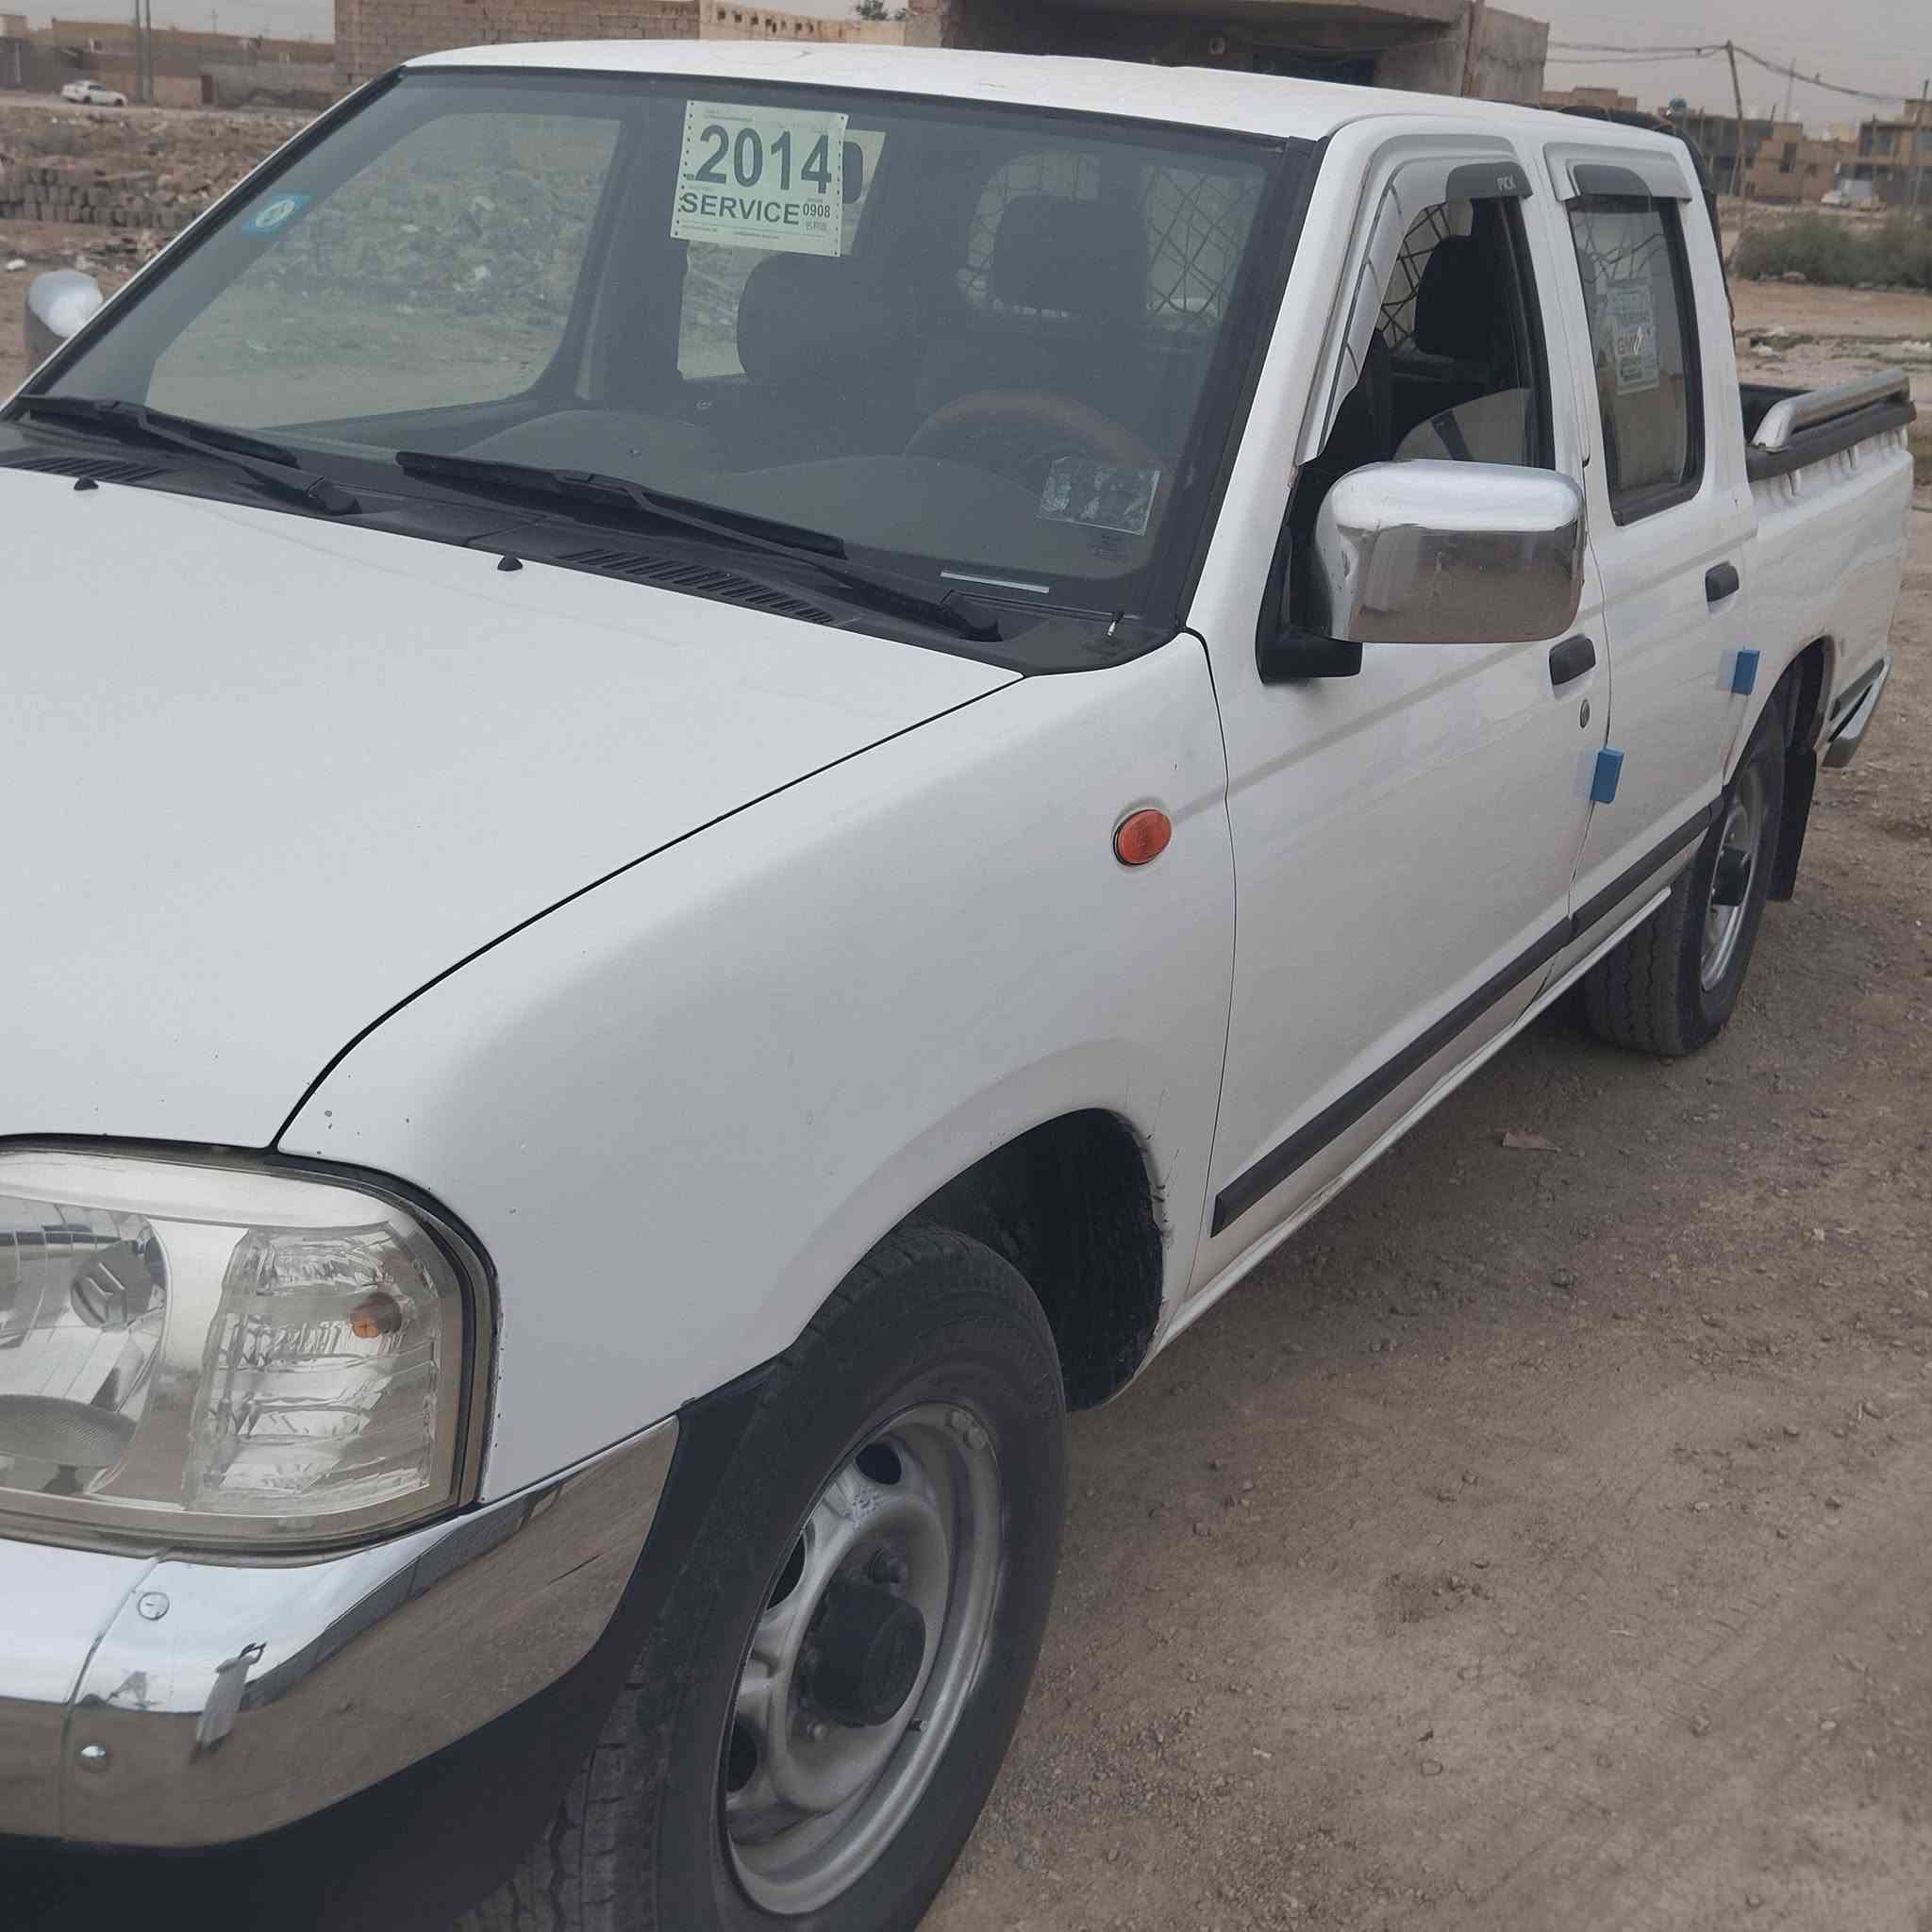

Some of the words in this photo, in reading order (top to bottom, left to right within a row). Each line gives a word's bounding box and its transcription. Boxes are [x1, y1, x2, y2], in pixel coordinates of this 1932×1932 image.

[695, 125, 832, 194] 2014
[680, 192, 800, 225] SERVICE
[803, 203, 830, 218] 0908
